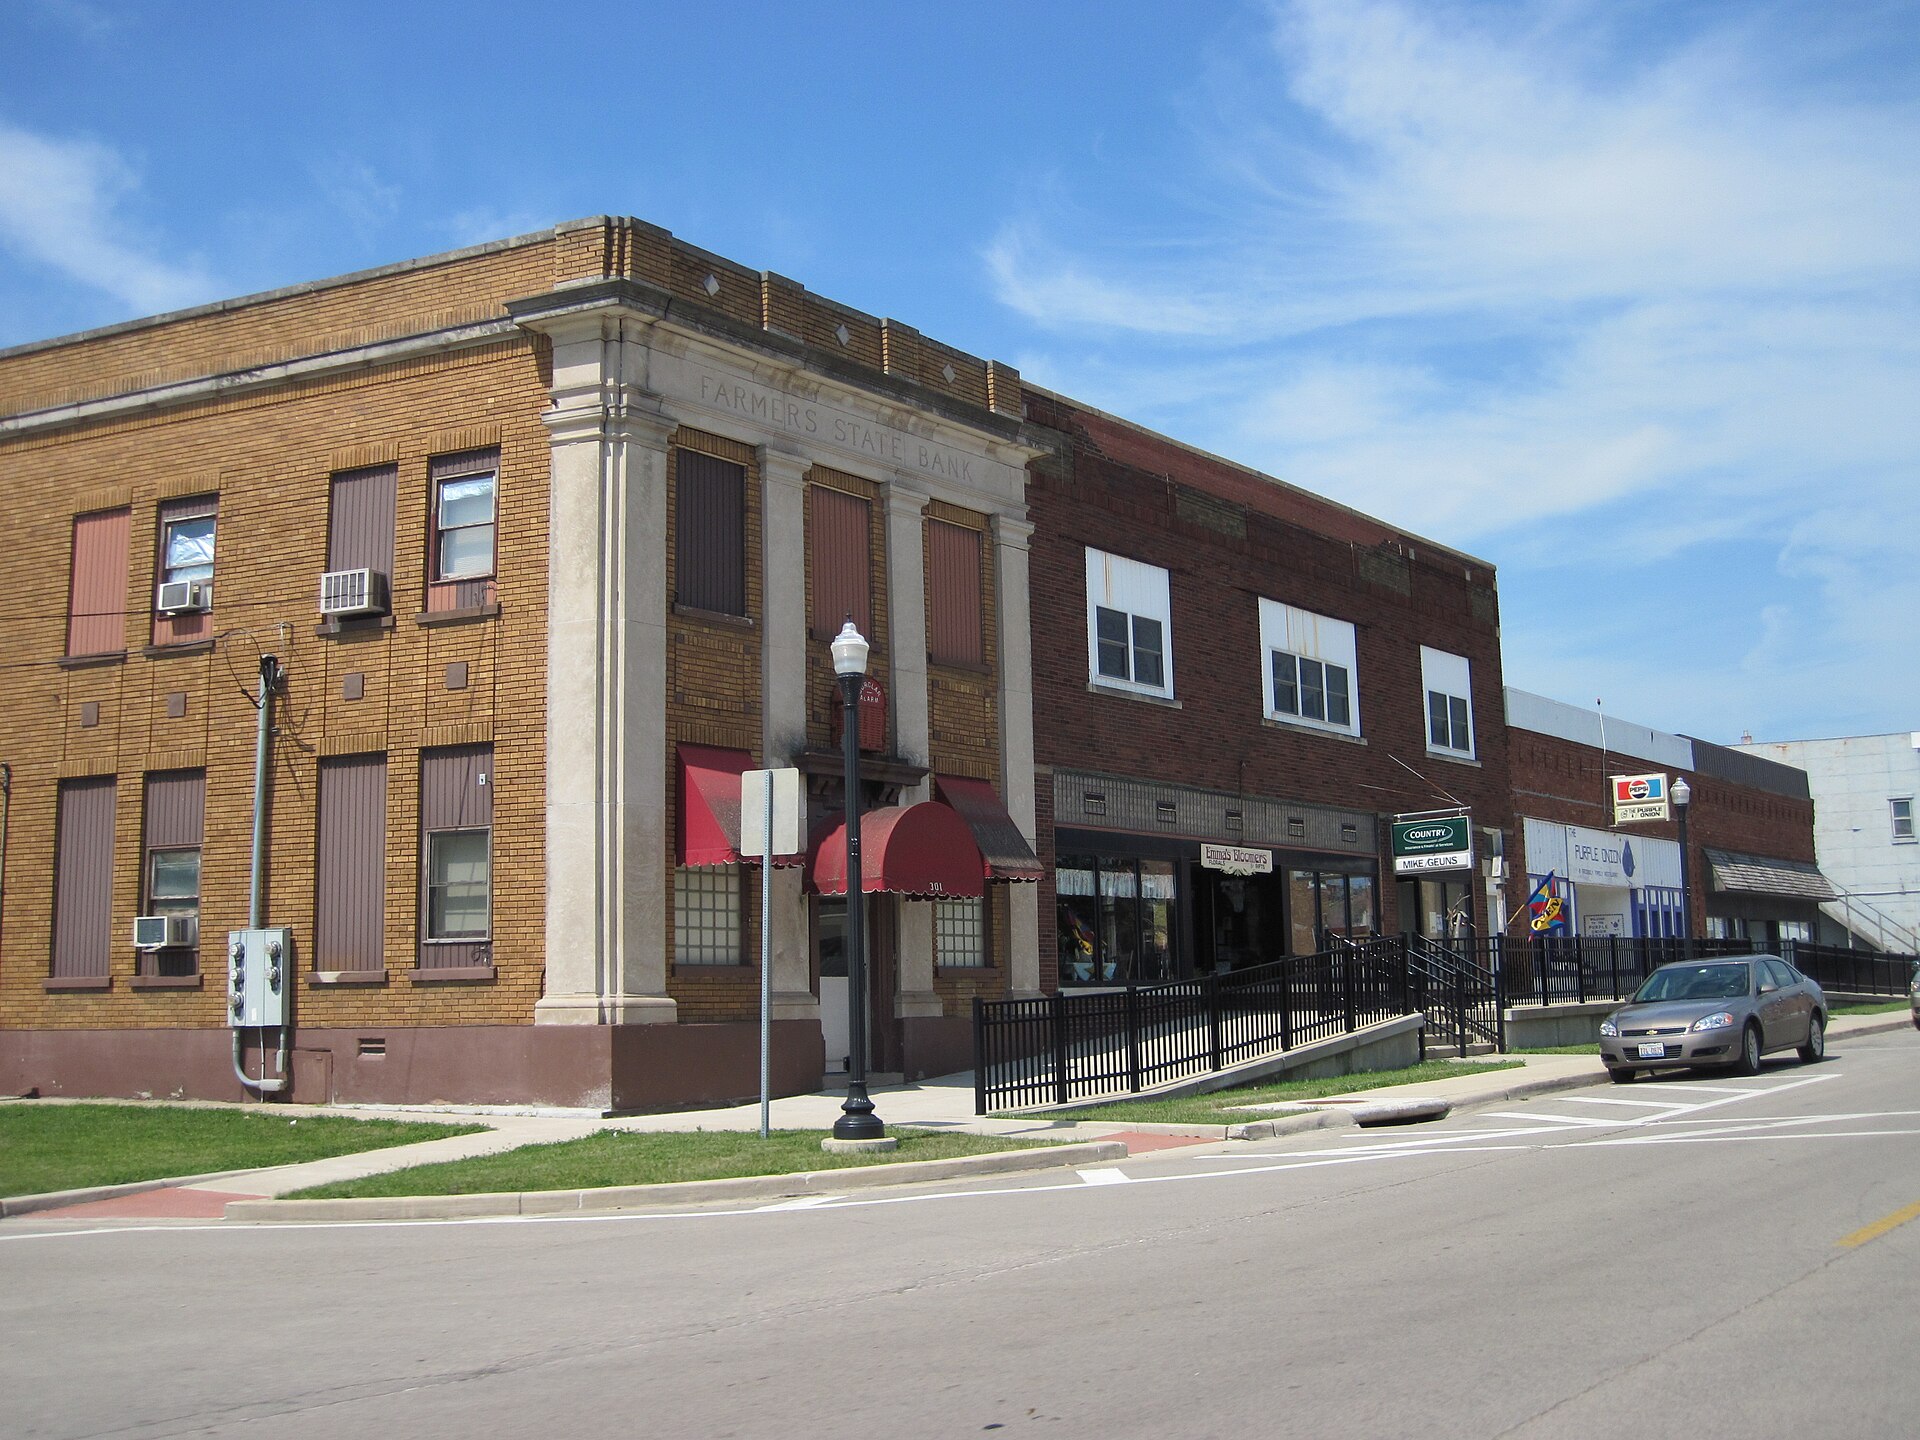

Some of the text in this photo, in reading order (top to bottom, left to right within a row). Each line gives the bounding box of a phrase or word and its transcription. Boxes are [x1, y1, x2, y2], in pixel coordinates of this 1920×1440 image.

[700, 375, 973, 482] FARMERS STATE BANK
[1410, 828, 1446, 839] COUNTRY
[1205, 846, 1267, 864] Emma's Bloomers
[1575, 844, 1621, 864] PURPLE ONION
[1403, 856, 1457, 869] MIKE GEUNS
[929, 882, 942, 891] 301
